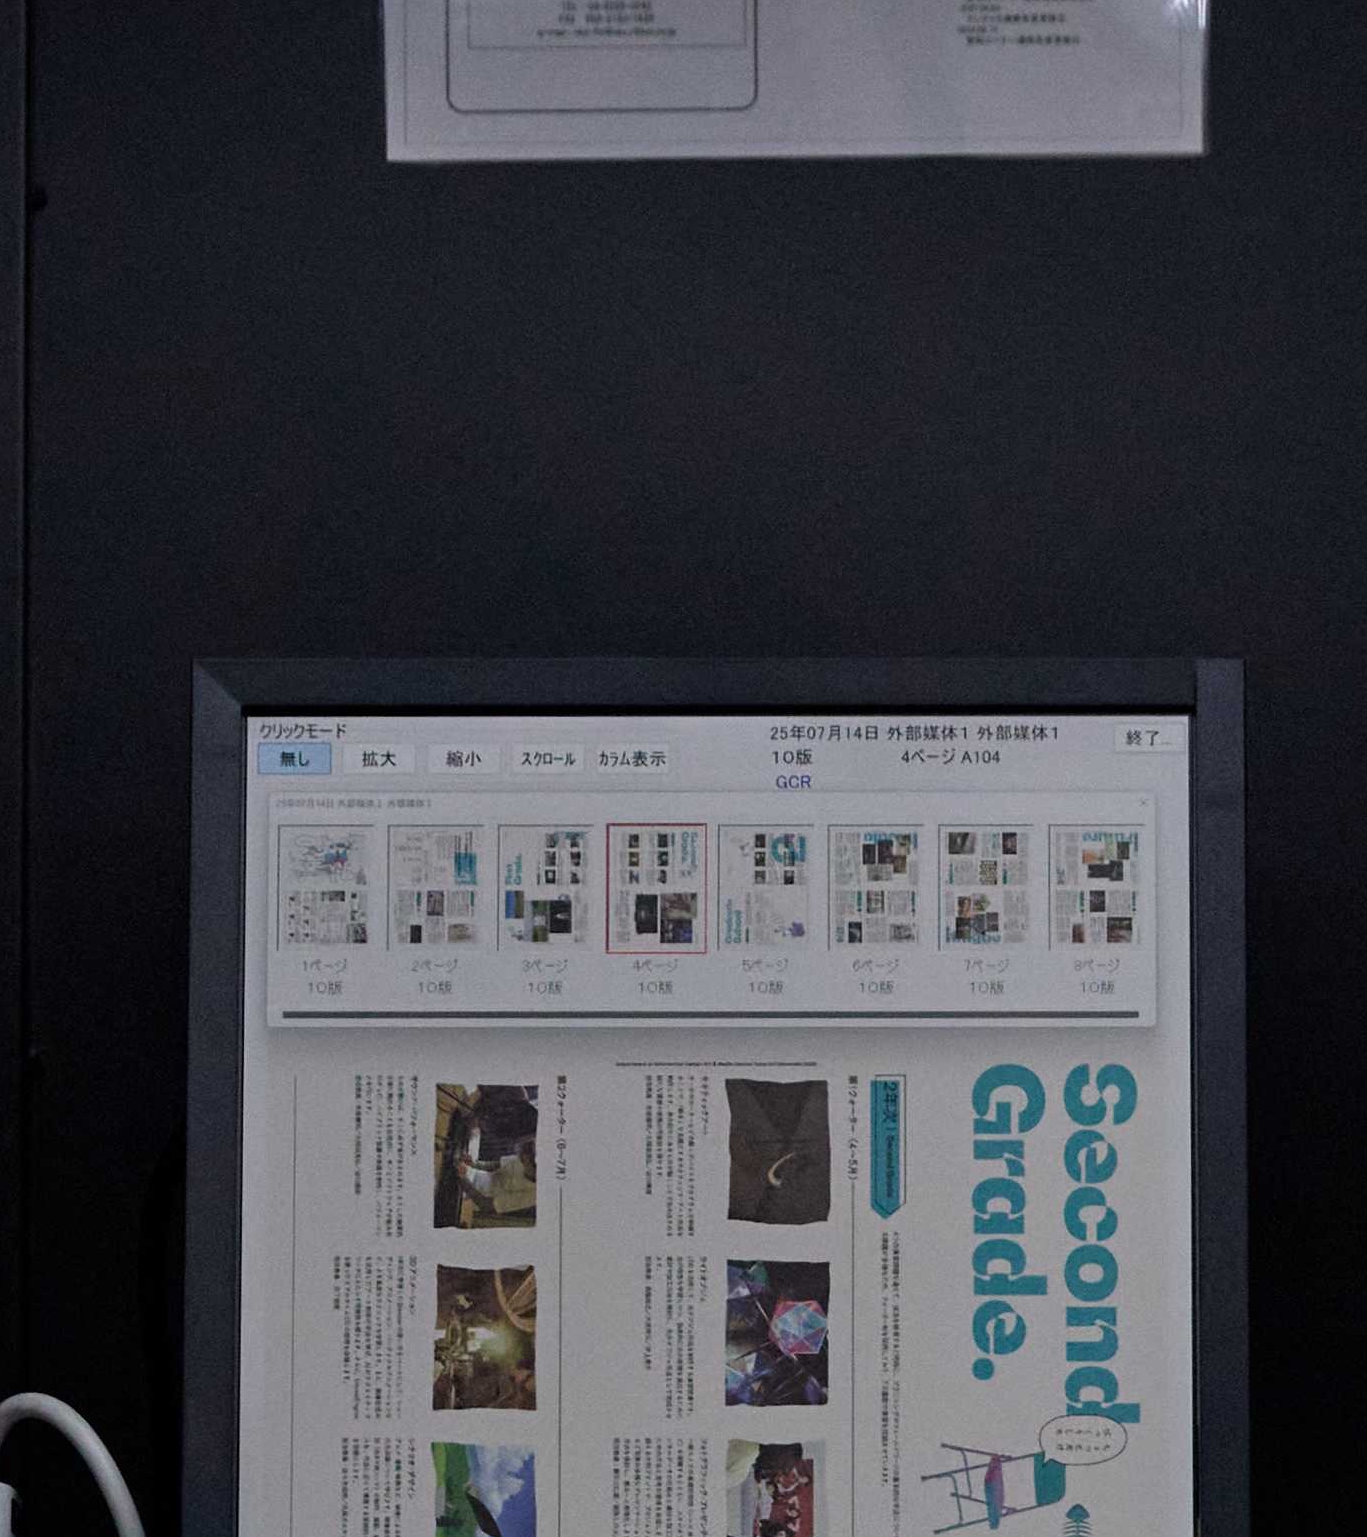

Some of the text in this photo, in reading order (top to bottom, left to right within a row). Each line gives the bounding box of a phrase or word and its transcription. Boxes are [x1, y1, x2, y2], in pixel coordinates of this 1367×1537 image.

[259, 722, 347, 739] クリックモード
[770, 725, 1058, 741] 25年07月14日 外部媒体1 外部媒体1
[279, 750, 310, 767] 無し
[361, 750, 396, 768] 拡大
[446, 750, 481, 768] 縮小
[521, 751, 576, 766] スクロール
[598, 750, 667, 767] カラム表示
[901, 749, 1001, 764] 4ページ A104
[776, 774, 812, 789] GCR
[303, 957, 349, 972] 1ページ
[411, 957, 458, 972] 2ページ
[522, 957, 568, 972] 3ページ
[632, 957, 678, 972] 4ページ
[742, 957, 789, 972] 5ページ
[852, 957, 899, 972] 6ページ
[965, 957, 1010, 972] 7ページ
[1074, 957, 1121, 972] 8ページ
[971, 1063, 1048, 1381] Grade.
[1063, 1063, 1141, 1424] Second
